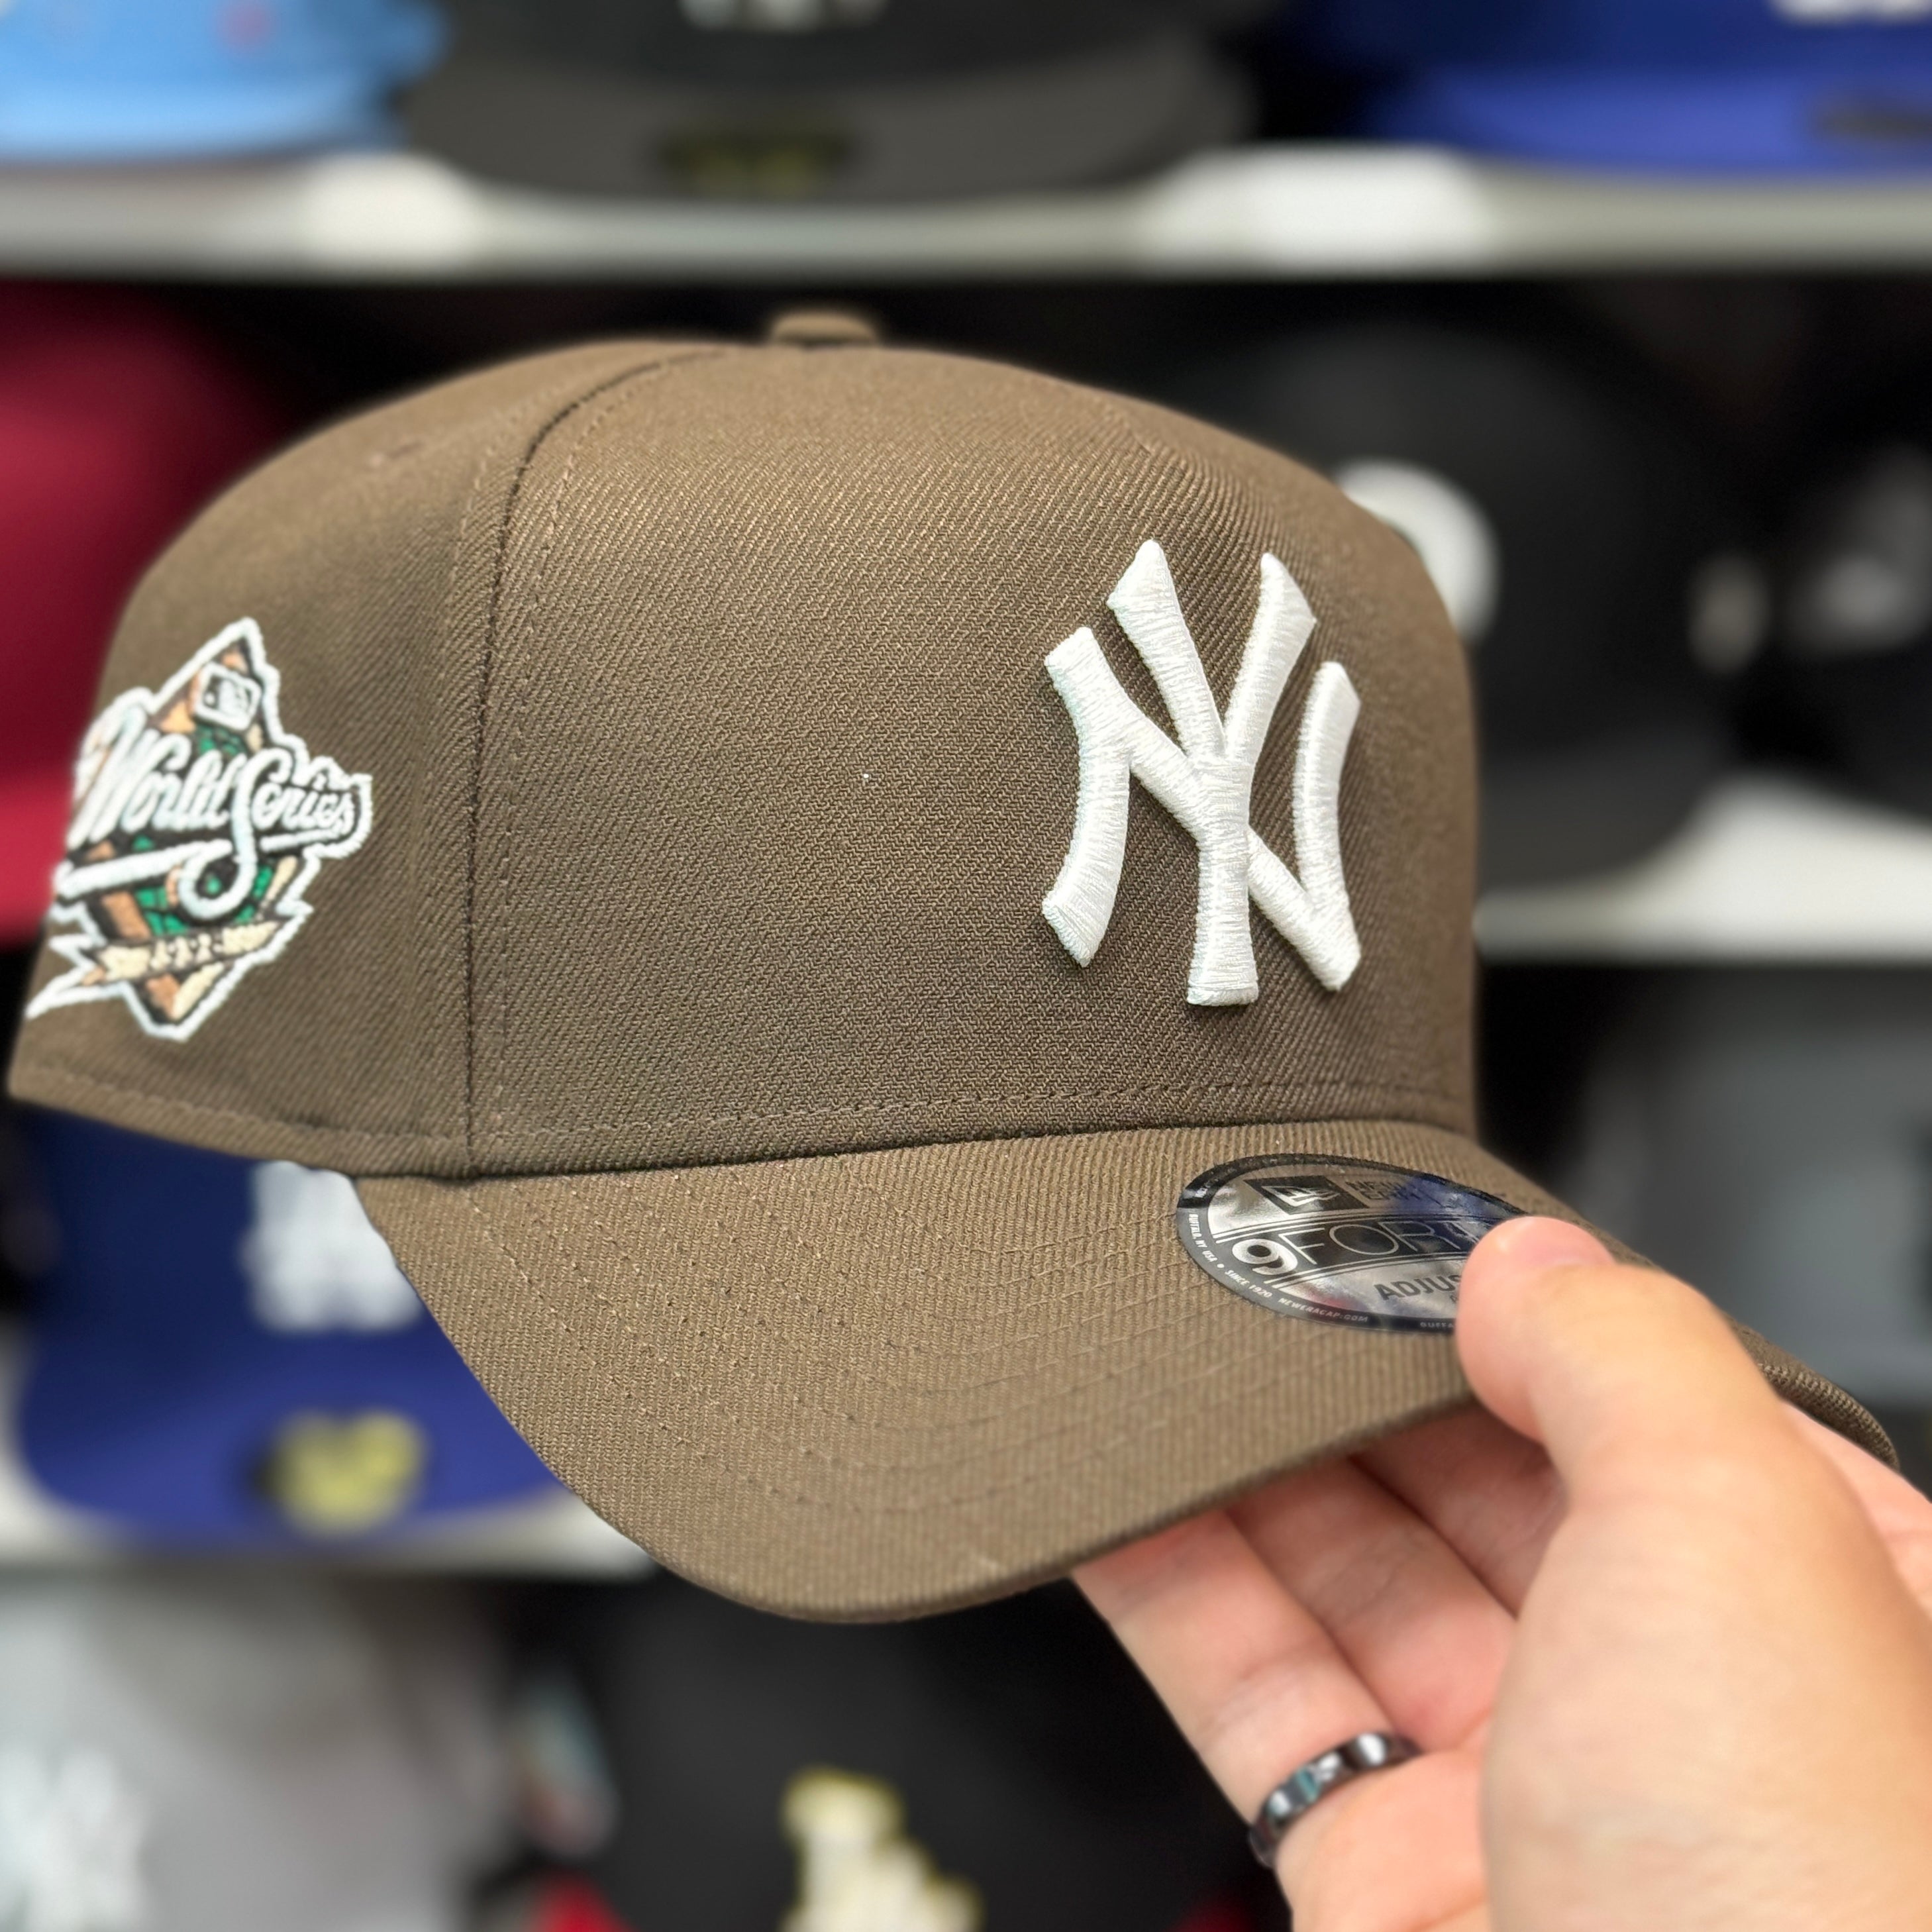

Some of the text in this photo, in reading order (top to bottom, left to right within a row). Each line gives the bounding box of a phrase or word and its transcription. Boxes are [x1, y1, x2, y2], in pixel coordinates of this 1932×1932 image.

[68, 705, 247, 850] World
[1042, 539, 1362, 1005] NY
[1202, 1249, 1218, 1263] USA
[1225, 1270, 1250, 1286] SINCE
[1248, 1284, 1273, 1298] 1920
[1232, 1220, 1481, 1275] 9FORT
